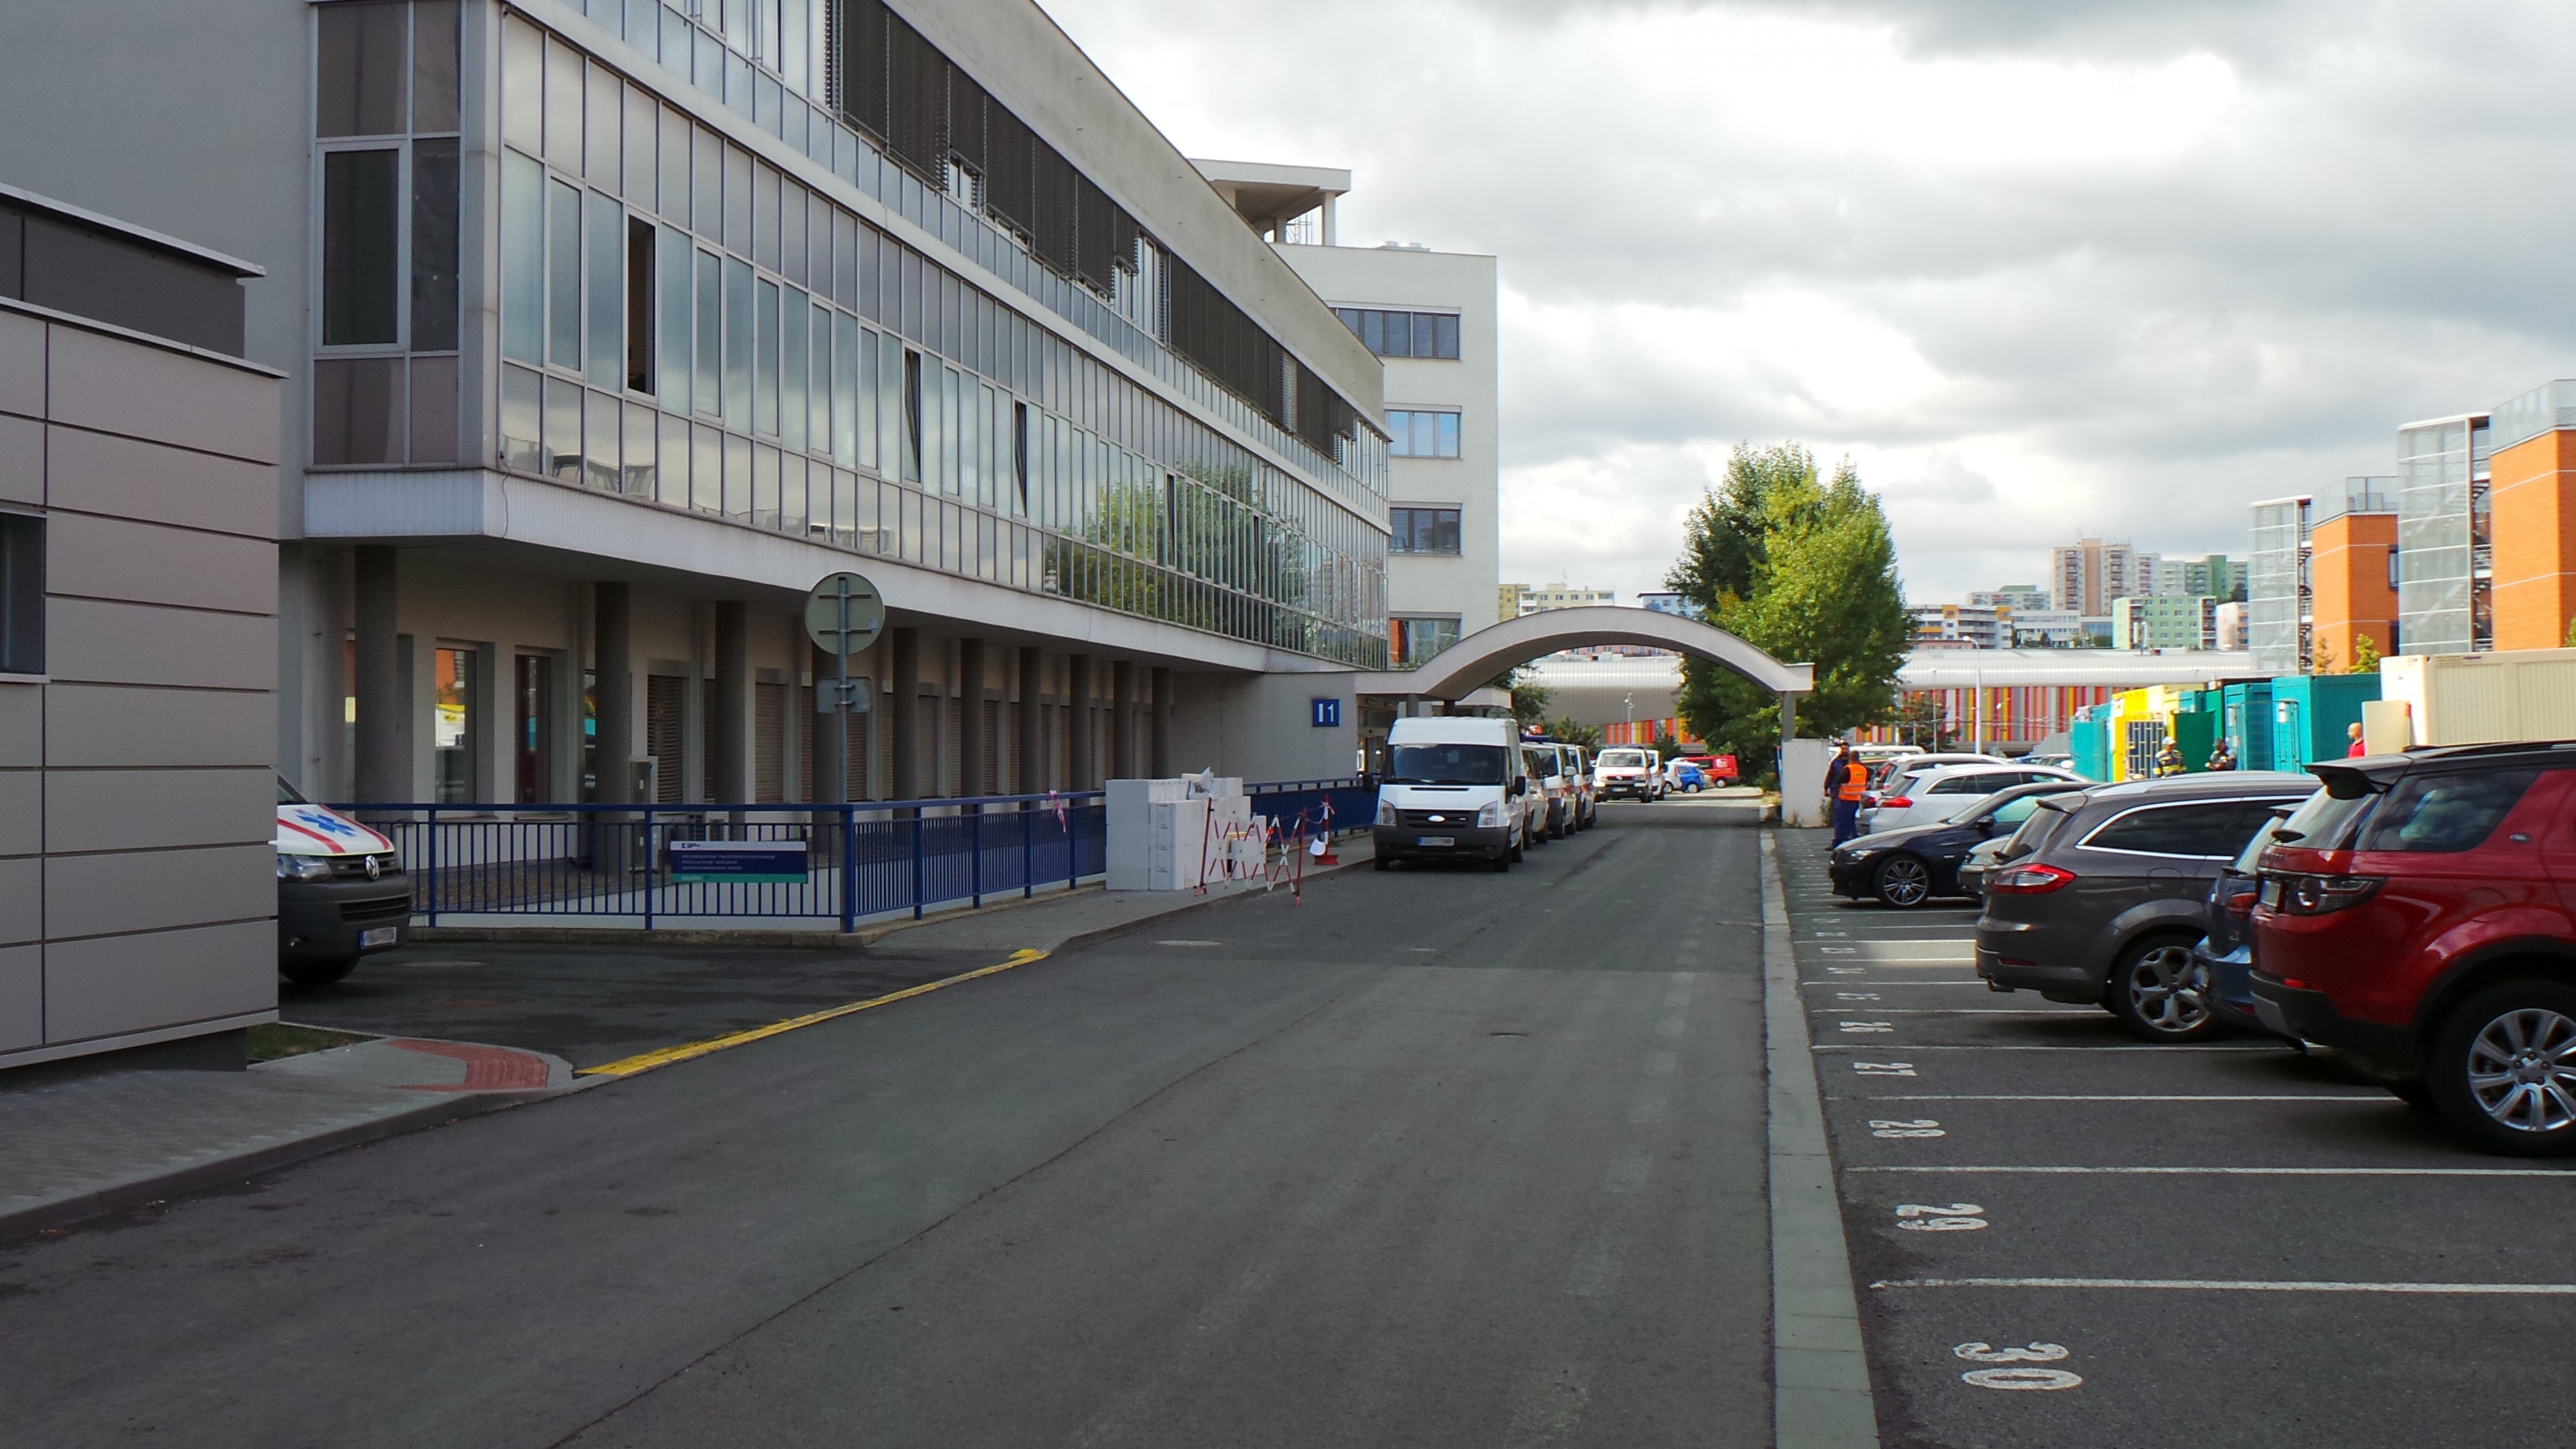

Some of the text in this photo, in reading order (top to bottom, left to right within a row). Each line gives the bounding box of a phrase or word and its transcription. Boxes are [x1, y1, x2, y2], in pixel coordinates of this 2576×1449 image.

[1853, 1062, 1918, 1076] 27
[1868, 1119, 1946, 1138] 28
[1895, 1203, 1989, 1231] 29
[1953, 1341, 2083, 1391] 30
